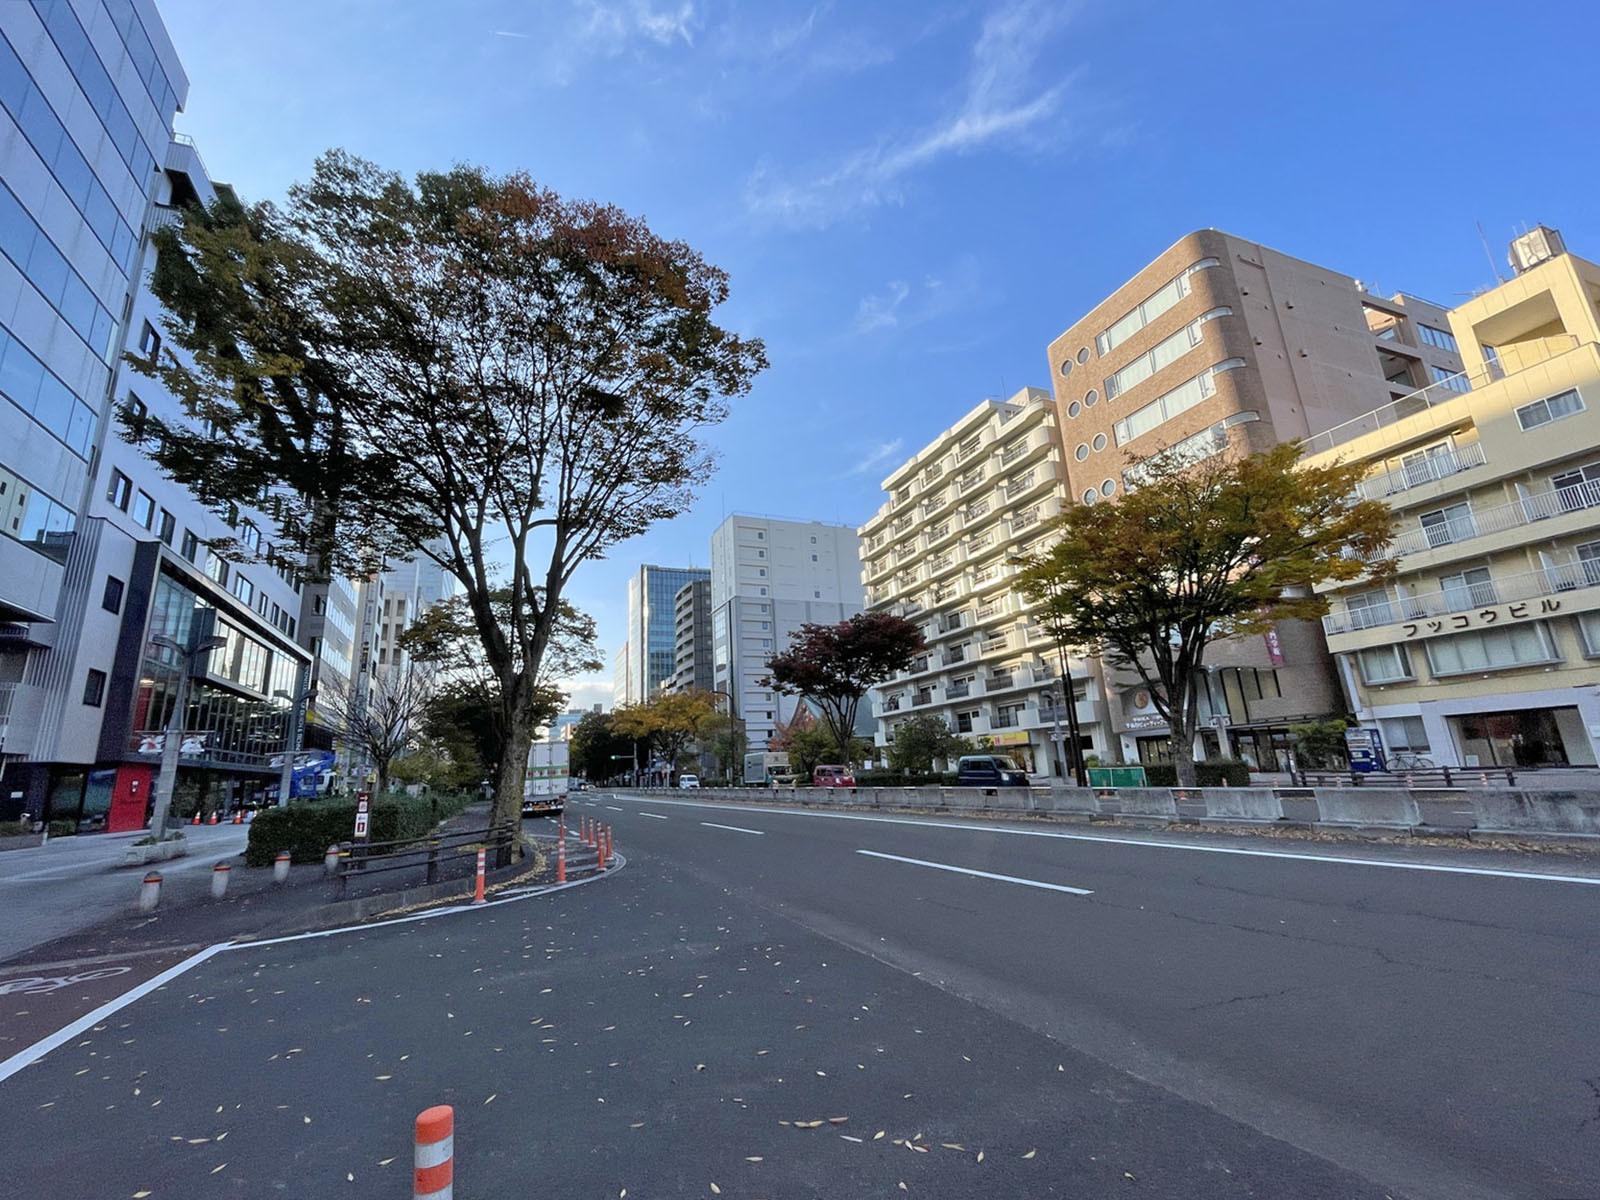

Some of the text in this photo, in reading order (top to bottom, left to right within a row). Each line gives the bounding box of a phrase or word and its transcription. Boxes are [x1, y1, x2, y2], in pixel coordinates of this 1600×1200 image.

[1402, 599, 1561, 637] フッコウビル
